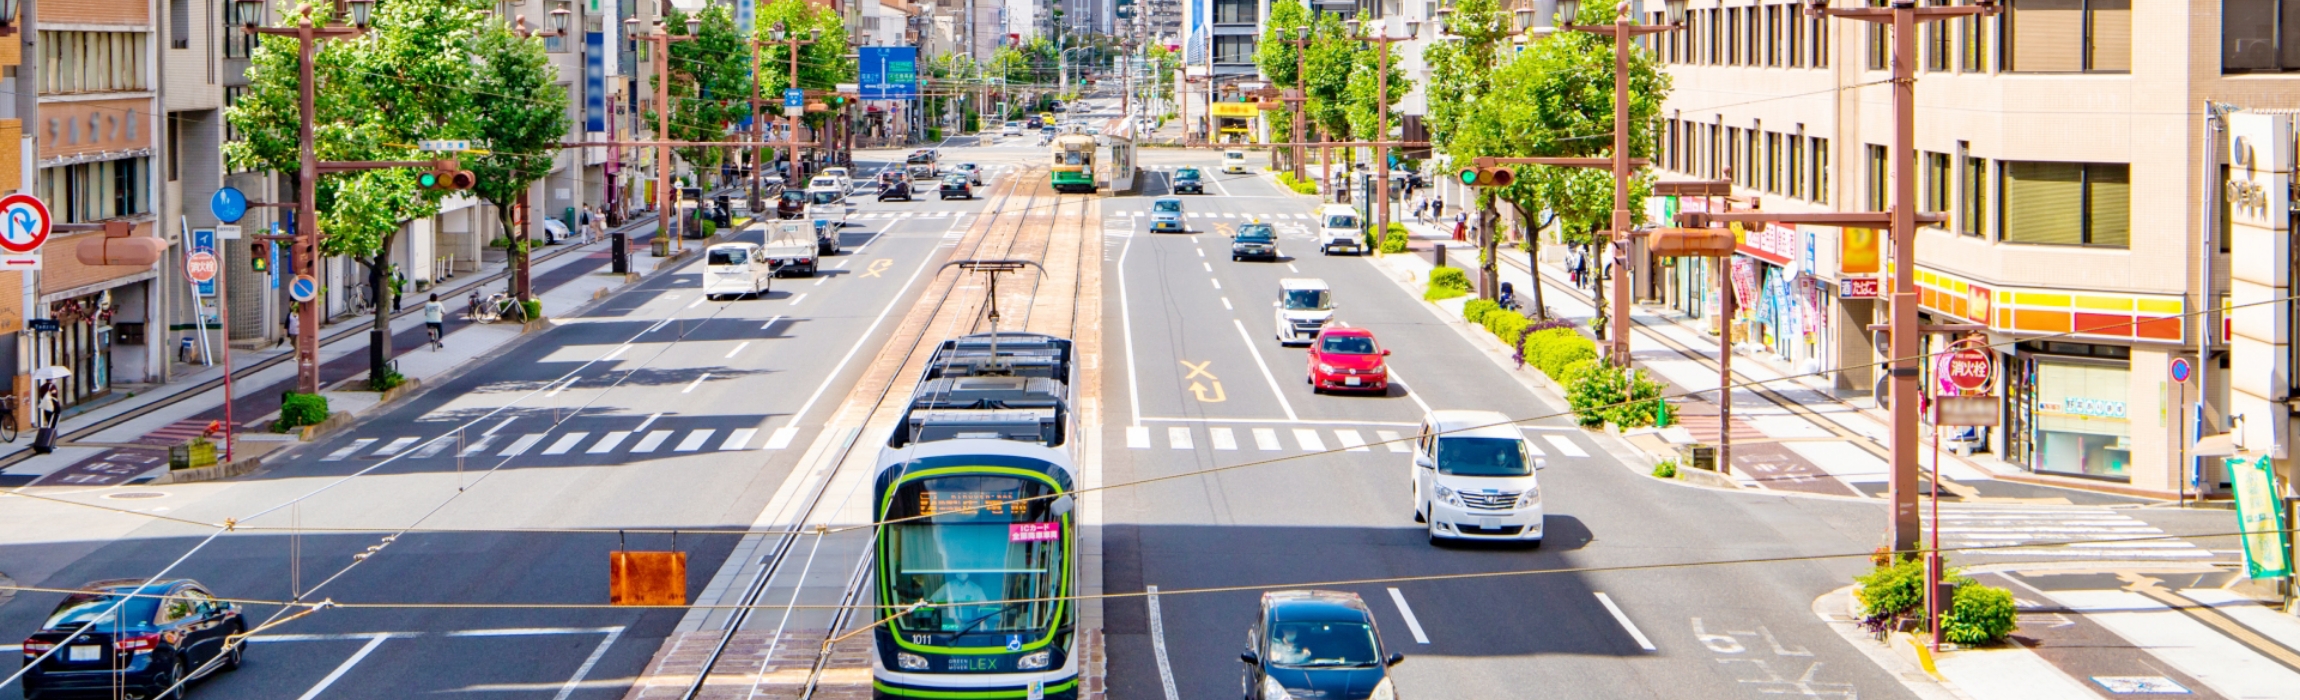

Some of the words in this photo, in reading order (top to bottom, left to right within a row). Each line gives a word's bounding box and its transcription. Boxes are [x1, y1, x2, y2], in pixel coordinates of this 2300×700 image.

[1853, 280, 1877, 296] たばこ
[1951, 361, 1987, 378] 消火栓
[912, 634, 931, 645] 1011
[969, 658, 997, 670] LEX
